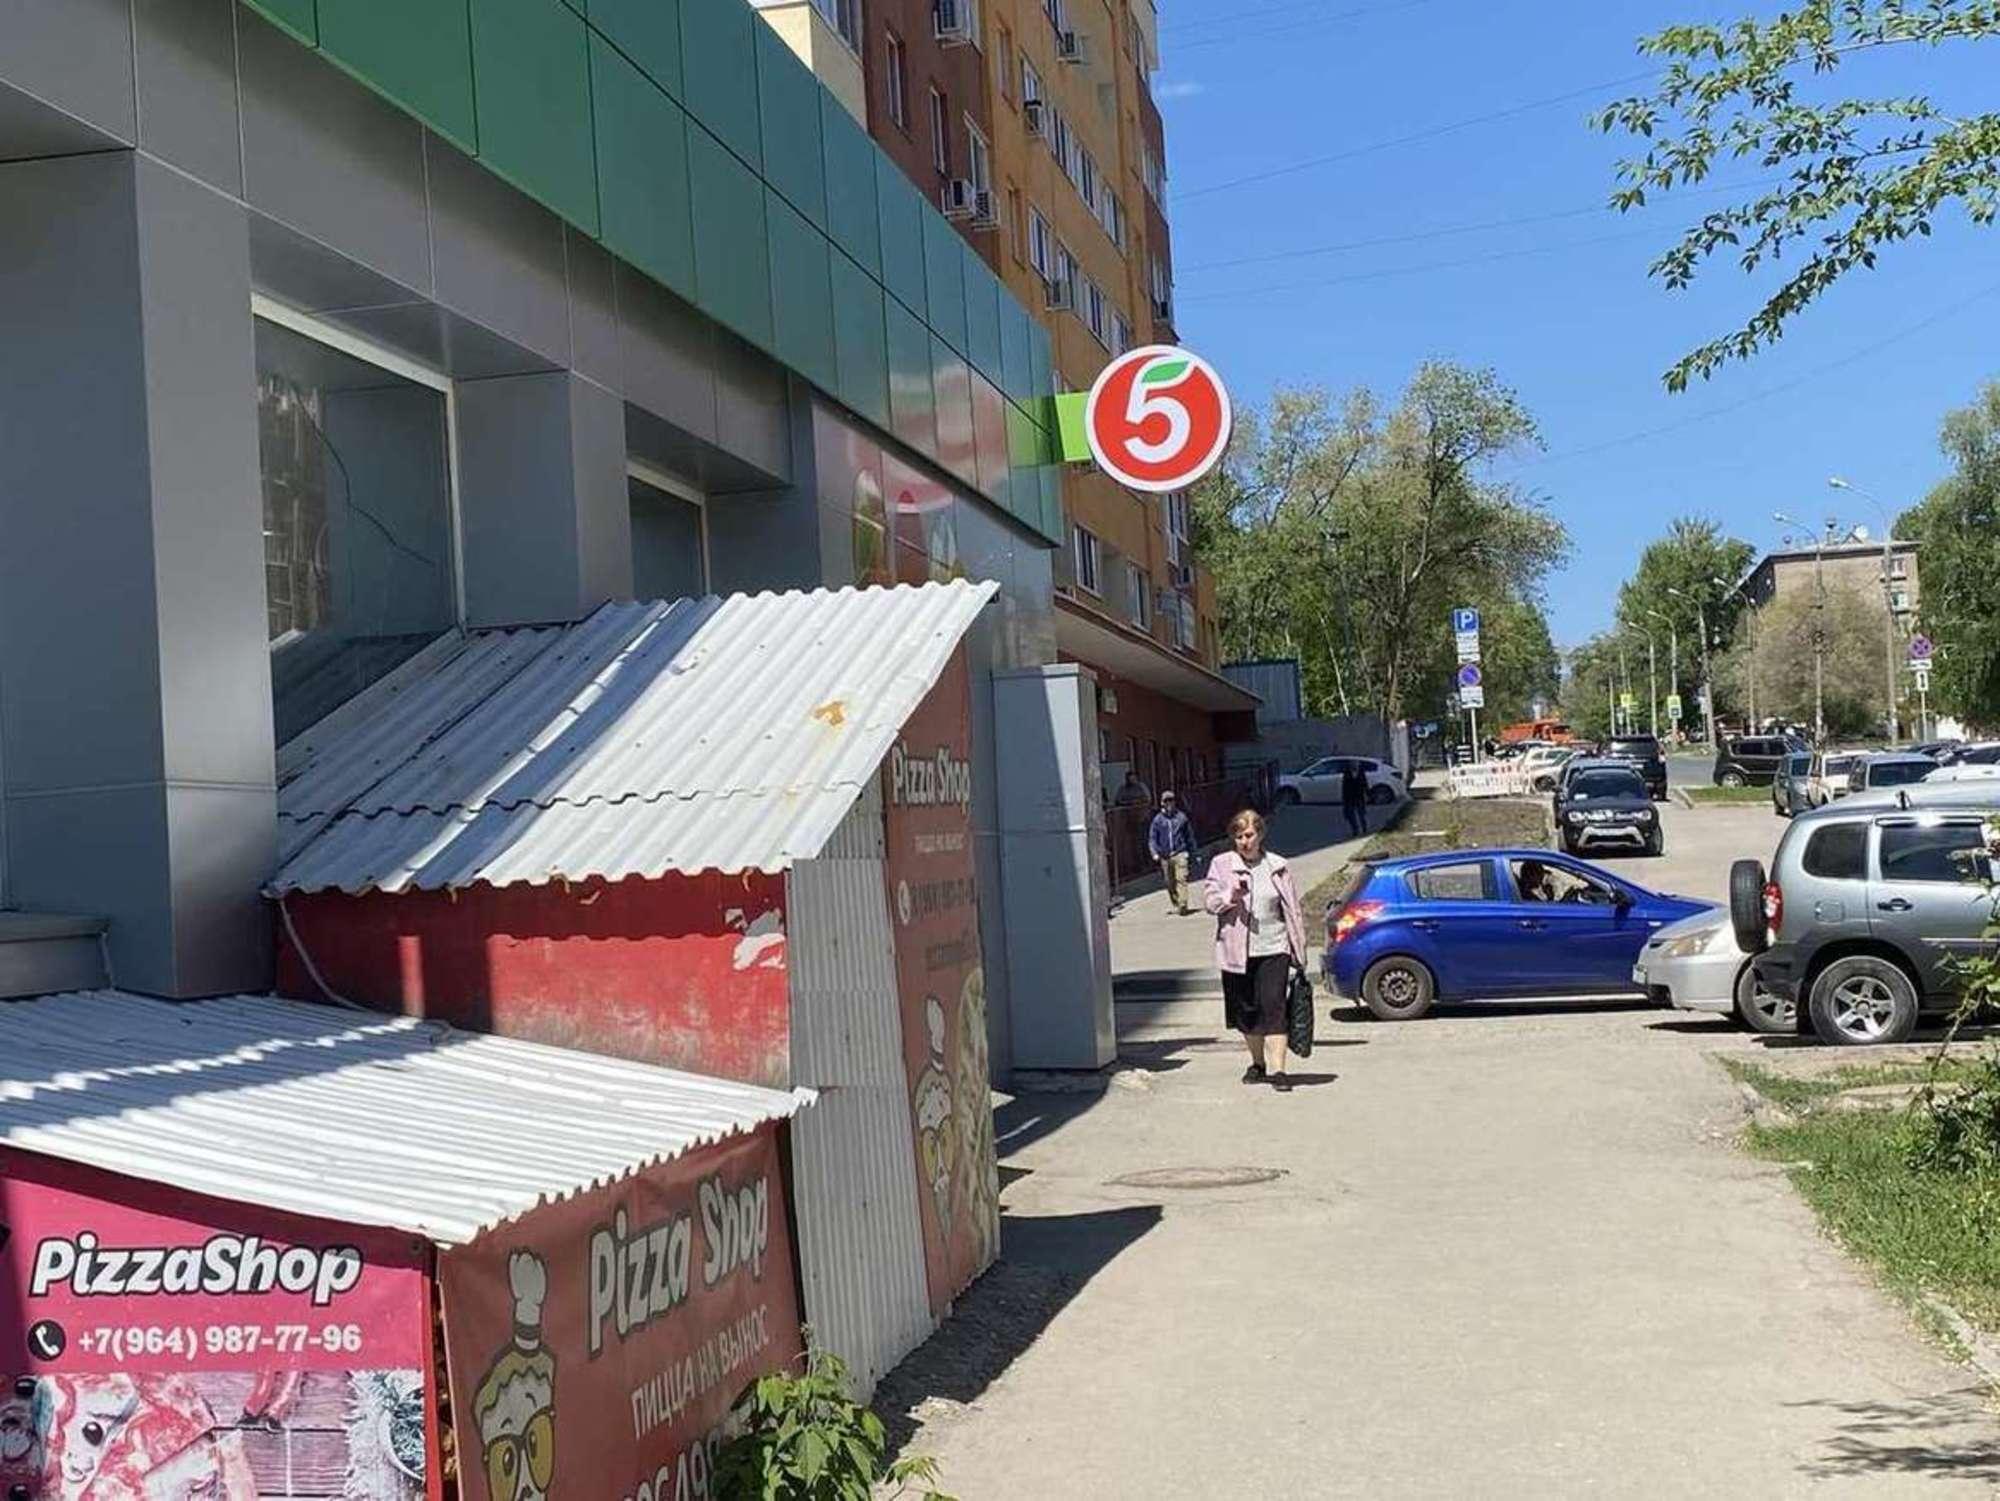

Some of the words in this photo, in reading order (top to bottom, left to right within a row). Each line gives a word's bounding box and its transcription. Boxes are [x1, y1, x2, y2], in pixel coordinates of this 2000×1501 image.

[1123, 355, 1193, 464] 5
[890, 740, 936, 805] Pizza
[937, 746, 971, 814] Shop
[29, 1231, 364, 1306] PizzaShop
[589, 1206, 692, 1357] Pizza
[699, 1174, 769, 1287] Shop
[78, 1325, 199, 1361] +7(964)
[205, 1323, 363, 1354] 987-77-96
[631, 1354, 697, 1440] ПИЦЦА
[697, 1339, 721, 1394] НА
[719, 1303, 769, 1376] ВЫНОС
